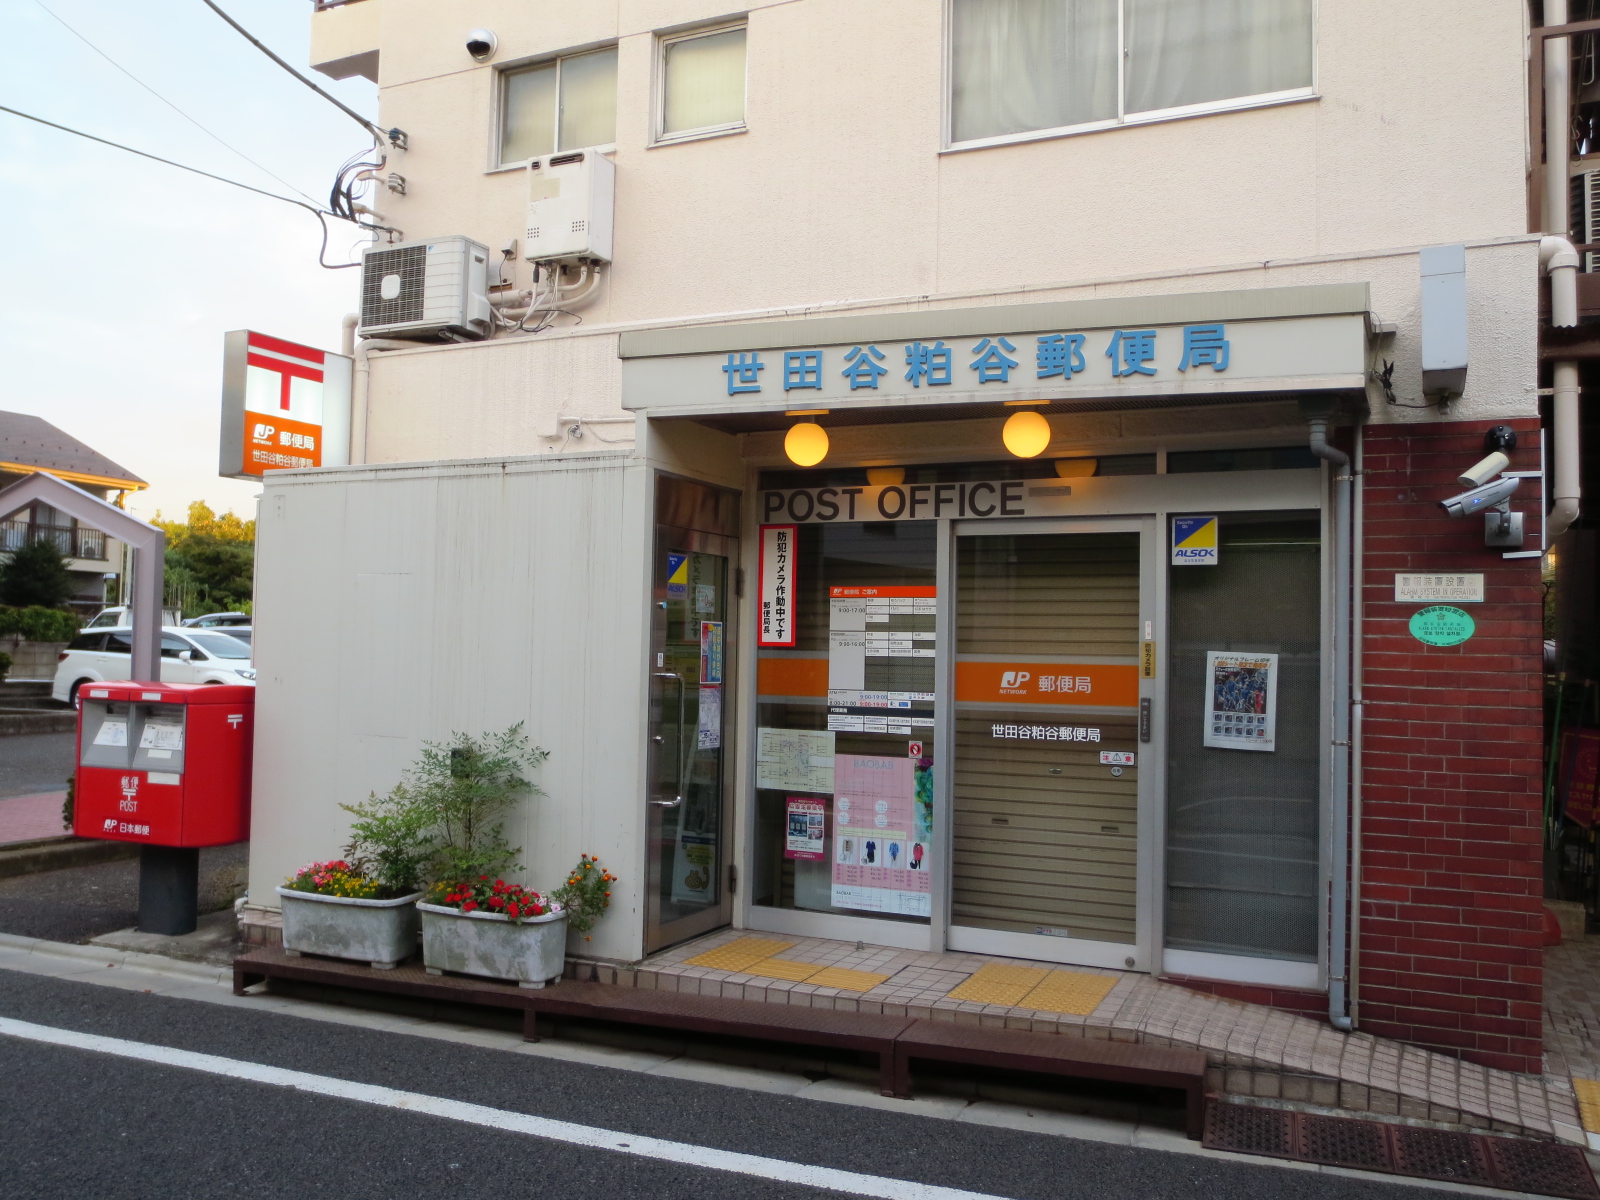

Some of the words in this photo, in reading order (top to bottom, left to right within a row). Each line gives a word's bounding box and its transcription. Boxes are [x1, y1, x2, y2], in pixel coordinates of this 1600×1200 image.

[722, 324, 1231, 396] 世田谷粕谷郵便局
[253, 423, 275, 440] JP
[279, 431, 315, 451] 郵便局
[252, 449, 314, 468] 世田谷粕谷郵便局
[763, 487, 864, 523] POST
[877, 481, 1026, 520] OFFICE
[1175, 549, 1215, 558] ALSOK
[667, 585, 687, 594] ALSOK
[775, 531, 788, 640] 防犯カメラ作動中です
[1401, 588, 1418, 596] ALARM
[1420, 588, 1441, 596] SYSTEM
[1443, 588, 1448, 596] IN
[1450, 588, 1477, 596] OPERATION
[763, 601, 771, 634] 郵便局長
[1000, 671, 1031, 688] JP
[1038, 675, 1092, 694] 郵便局
[991, 724, 1101, 743] 世田谷粕谷郵便局
[854, 759, 894, 770] BAOBAB
[121, 776, 139, 790] 郵便
[120, 800, 138, 812] POST
[120, 822, 150, 836] 日本郵便
